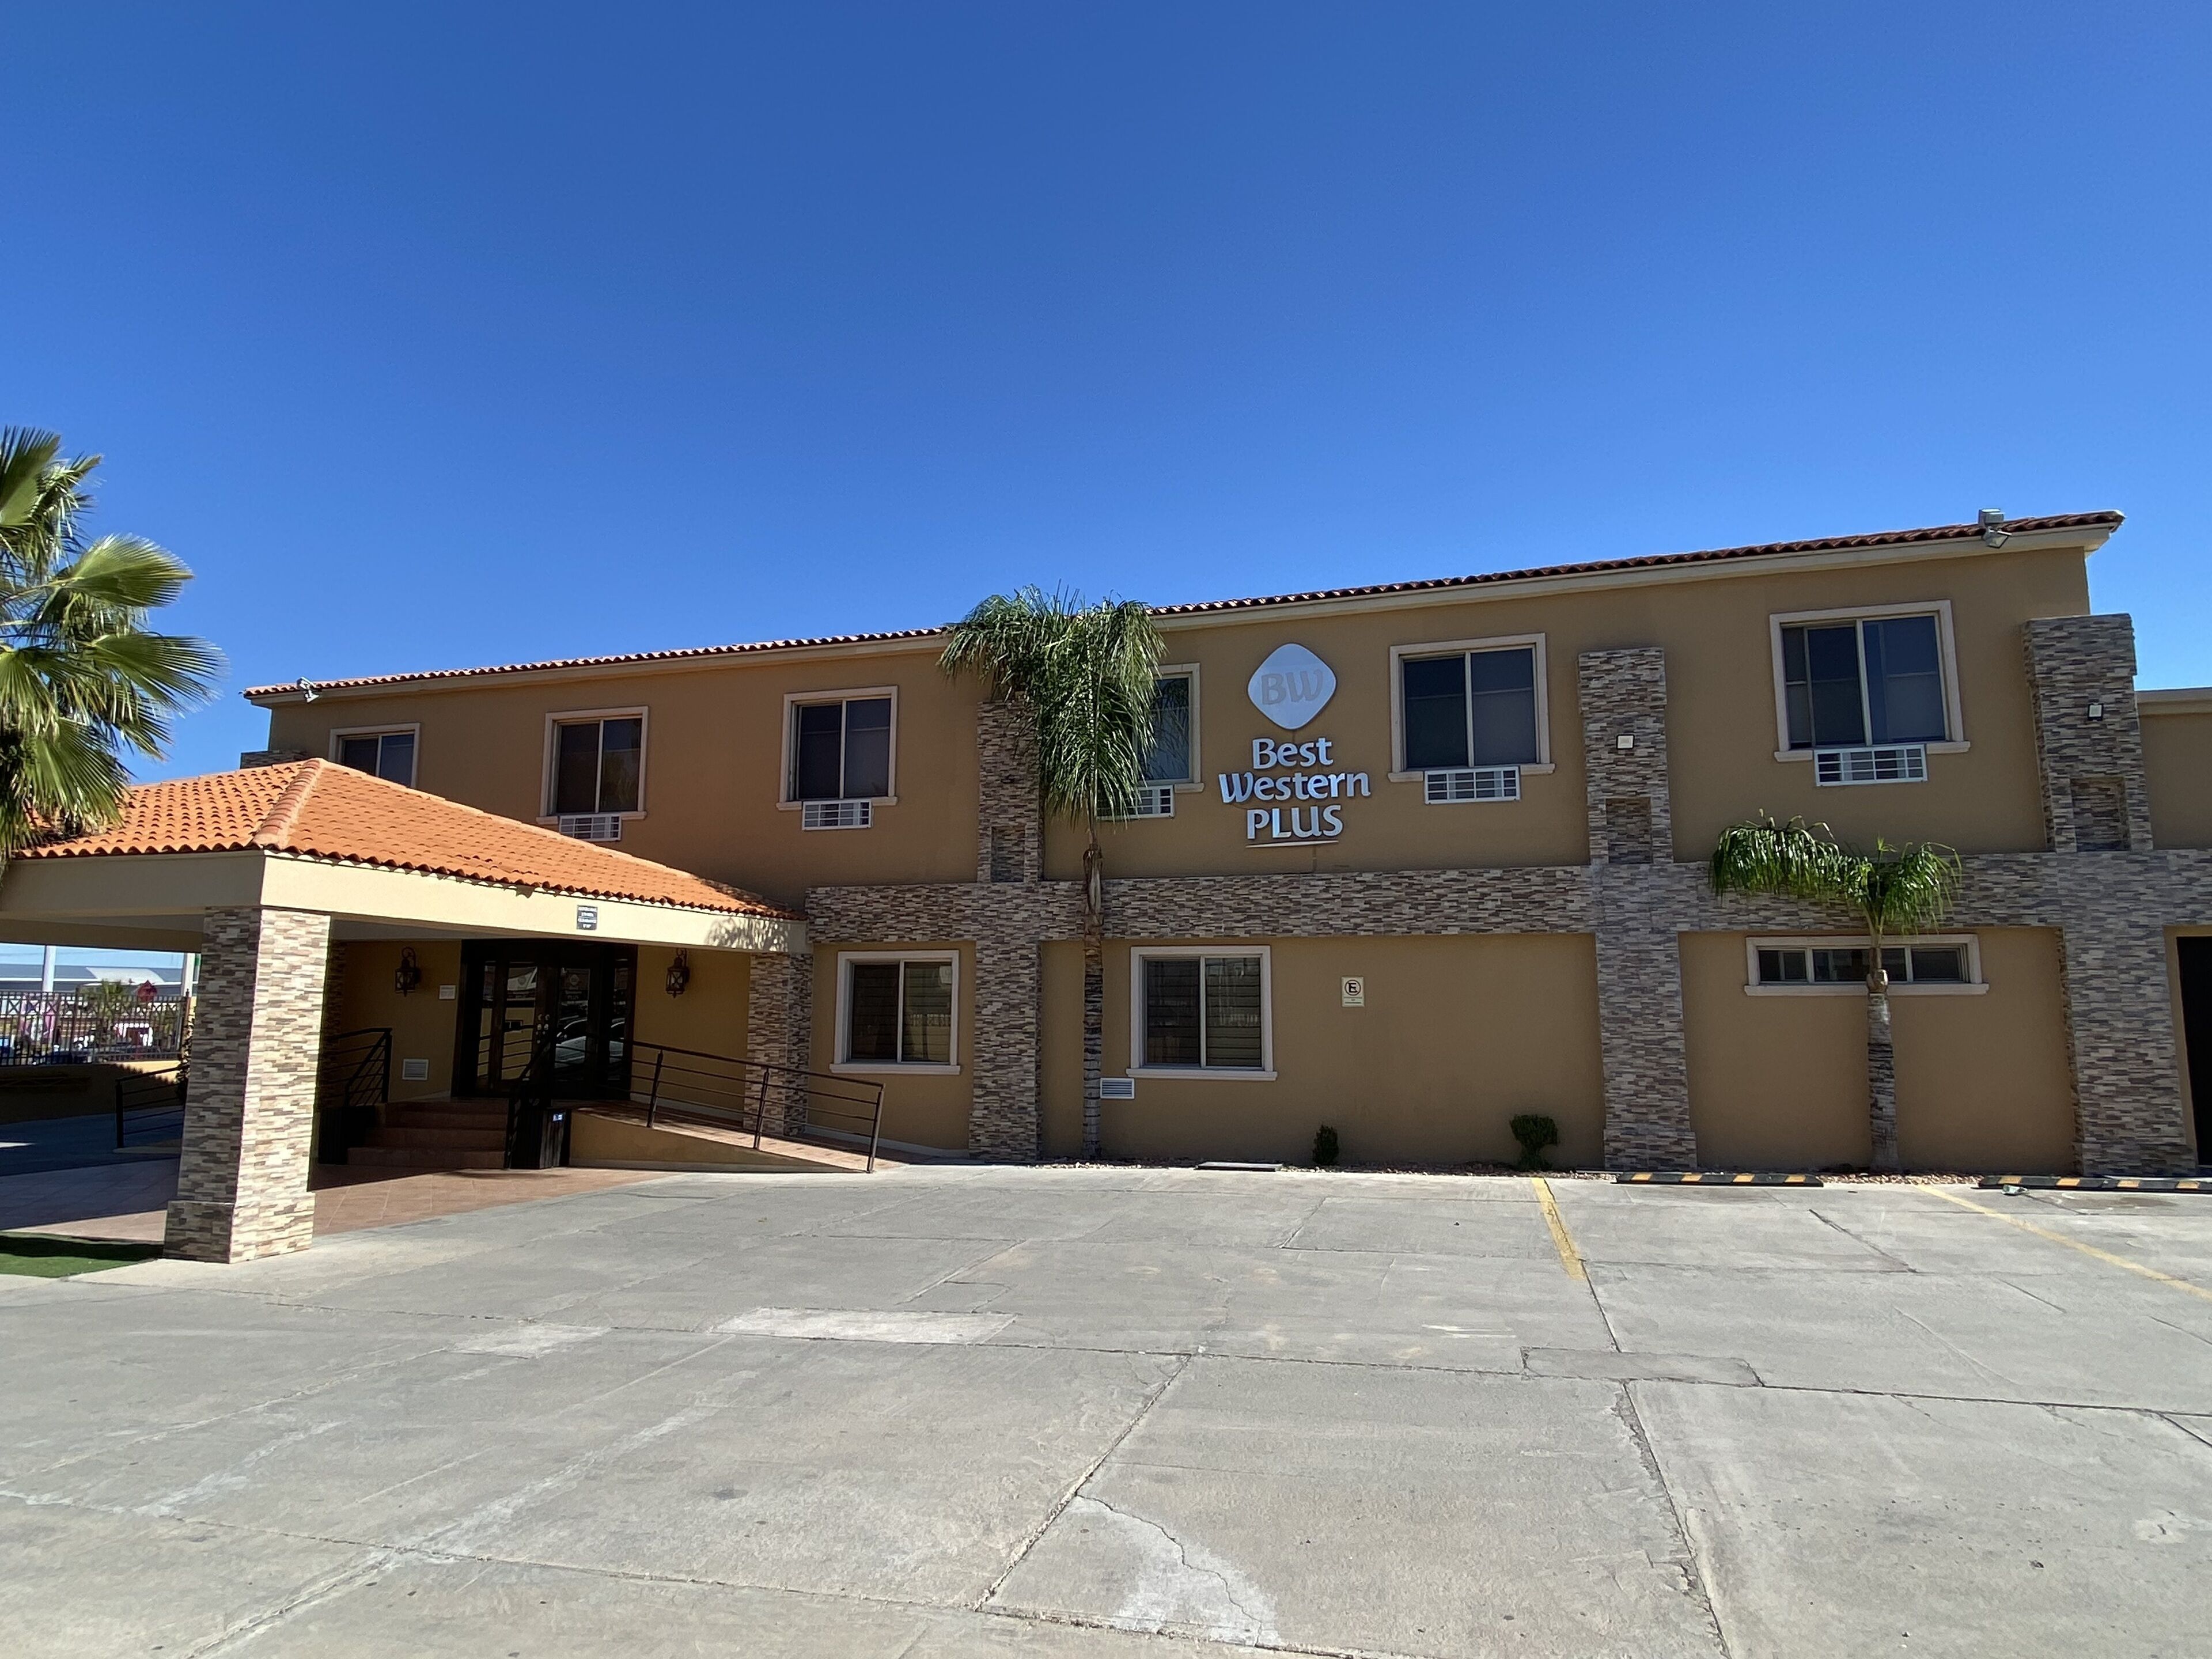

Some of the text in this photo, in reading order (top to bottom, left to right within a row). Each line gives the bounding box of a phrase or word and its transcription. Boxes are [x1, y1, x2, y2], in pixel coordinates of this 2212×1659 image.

[1260, 670, 1324, 705] BW
[1252, 737, 1334, 770] Best
[1218, 772, 1372, 804] Western
[1247, 805, 1343, 839] PLUS
